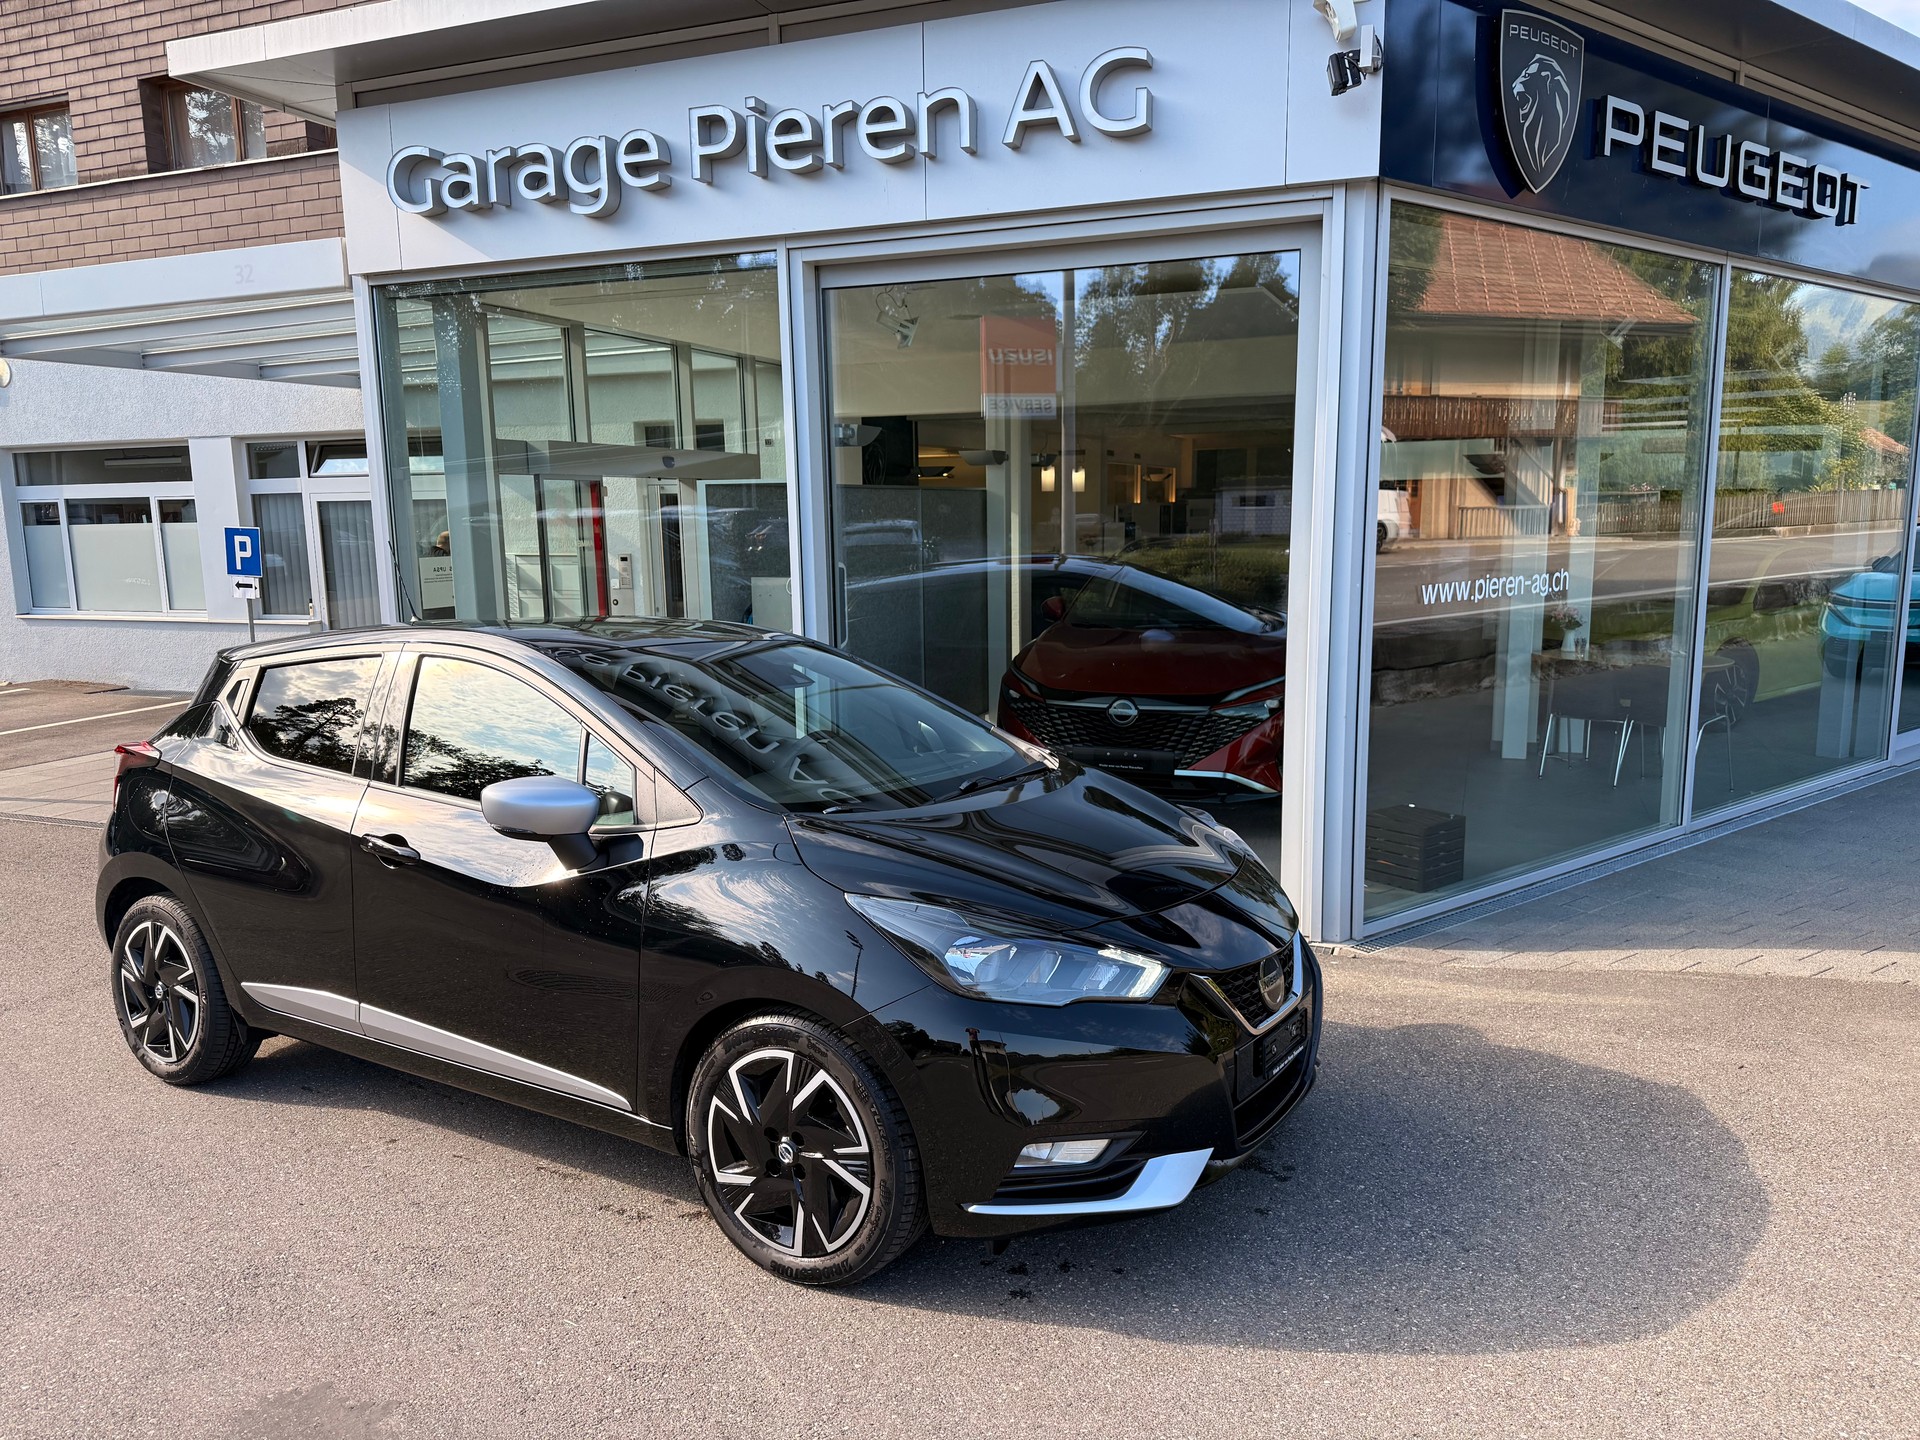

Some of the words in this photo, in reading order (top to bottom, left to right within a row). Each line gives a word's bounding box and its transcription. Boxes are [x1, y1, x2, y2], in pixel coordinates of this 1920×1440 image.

[1508, 24, 1579, 58] PEUGEOT
[385, 128, 672, 218] Garage
[688, 86, 978, 184] Pieren
[1002, 45, 1154, 149] AG
[1603, 94, 1871, 226] PEUGEOT
[234, 264, 255, 284] 32
[233, 535, 252, 570] P
[1421, 568, 1570, 606] www.pieren-ag.ch
